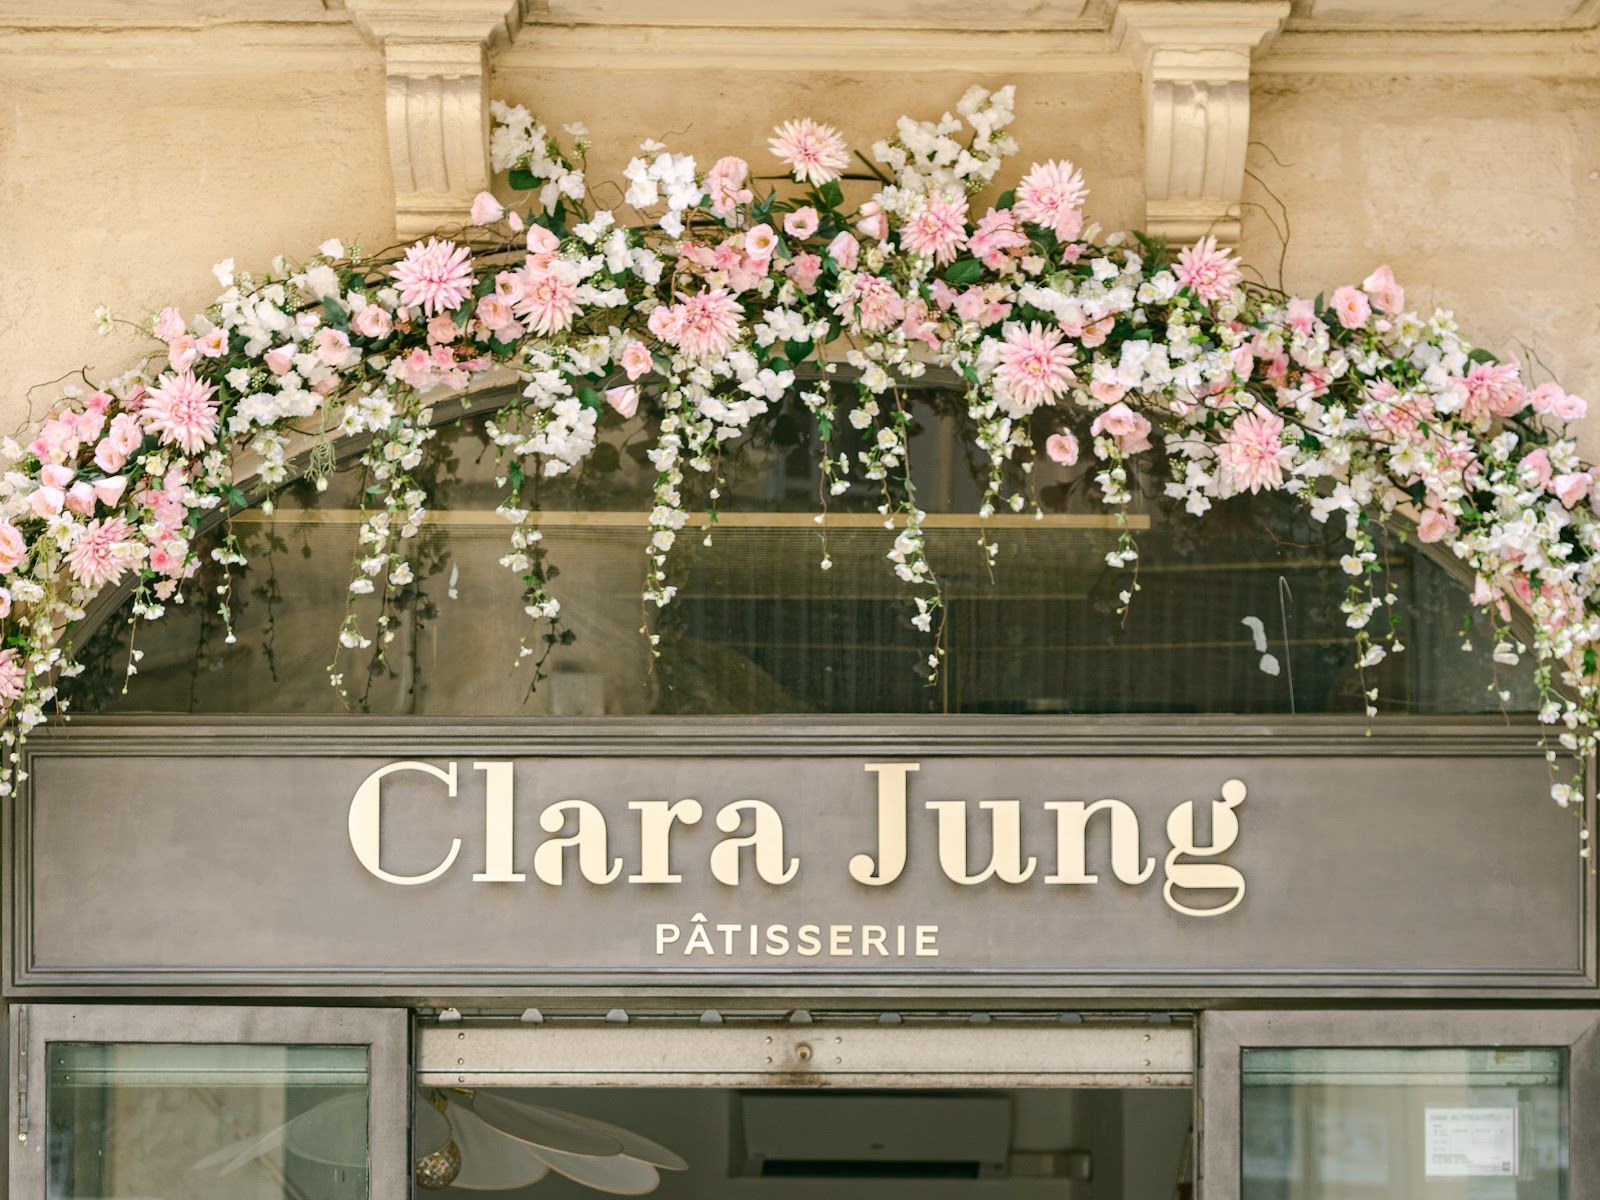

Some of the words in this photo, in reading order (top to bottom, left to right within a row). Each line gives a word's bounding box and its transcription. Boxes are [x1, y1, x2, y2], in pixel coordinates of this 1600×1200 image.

[348, 760, 800, 886] Clara
[848, 762, 1248, 917] Jung
[655, 912, 940, 957] PÂTISSERIE
